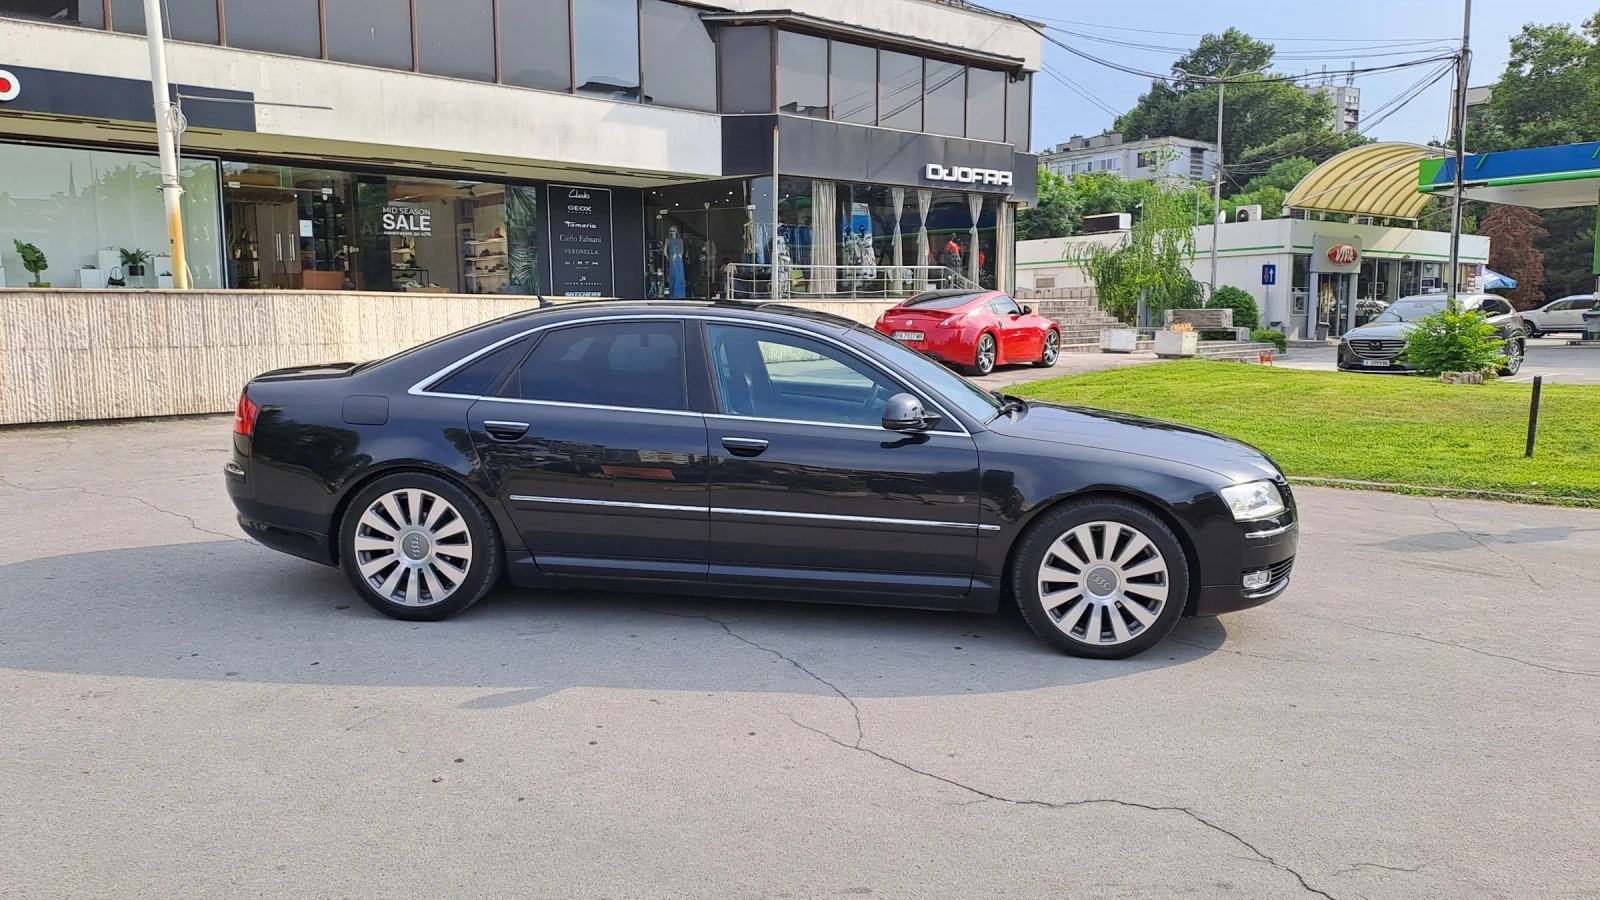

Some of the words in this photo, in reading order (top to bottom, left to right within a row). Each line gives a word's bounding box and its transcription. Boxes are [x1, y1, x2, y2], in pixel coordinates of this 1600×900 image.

[926, 163, 1012, 186] DJOFRA
[382, 206, 398, 214] MID
[382, 214, 431, 231] SALE
[564, 220, 597, 229] Tamaris
[559, 233, 578, 242] Carlo
[579, 235, 602, 243] Fabiani
